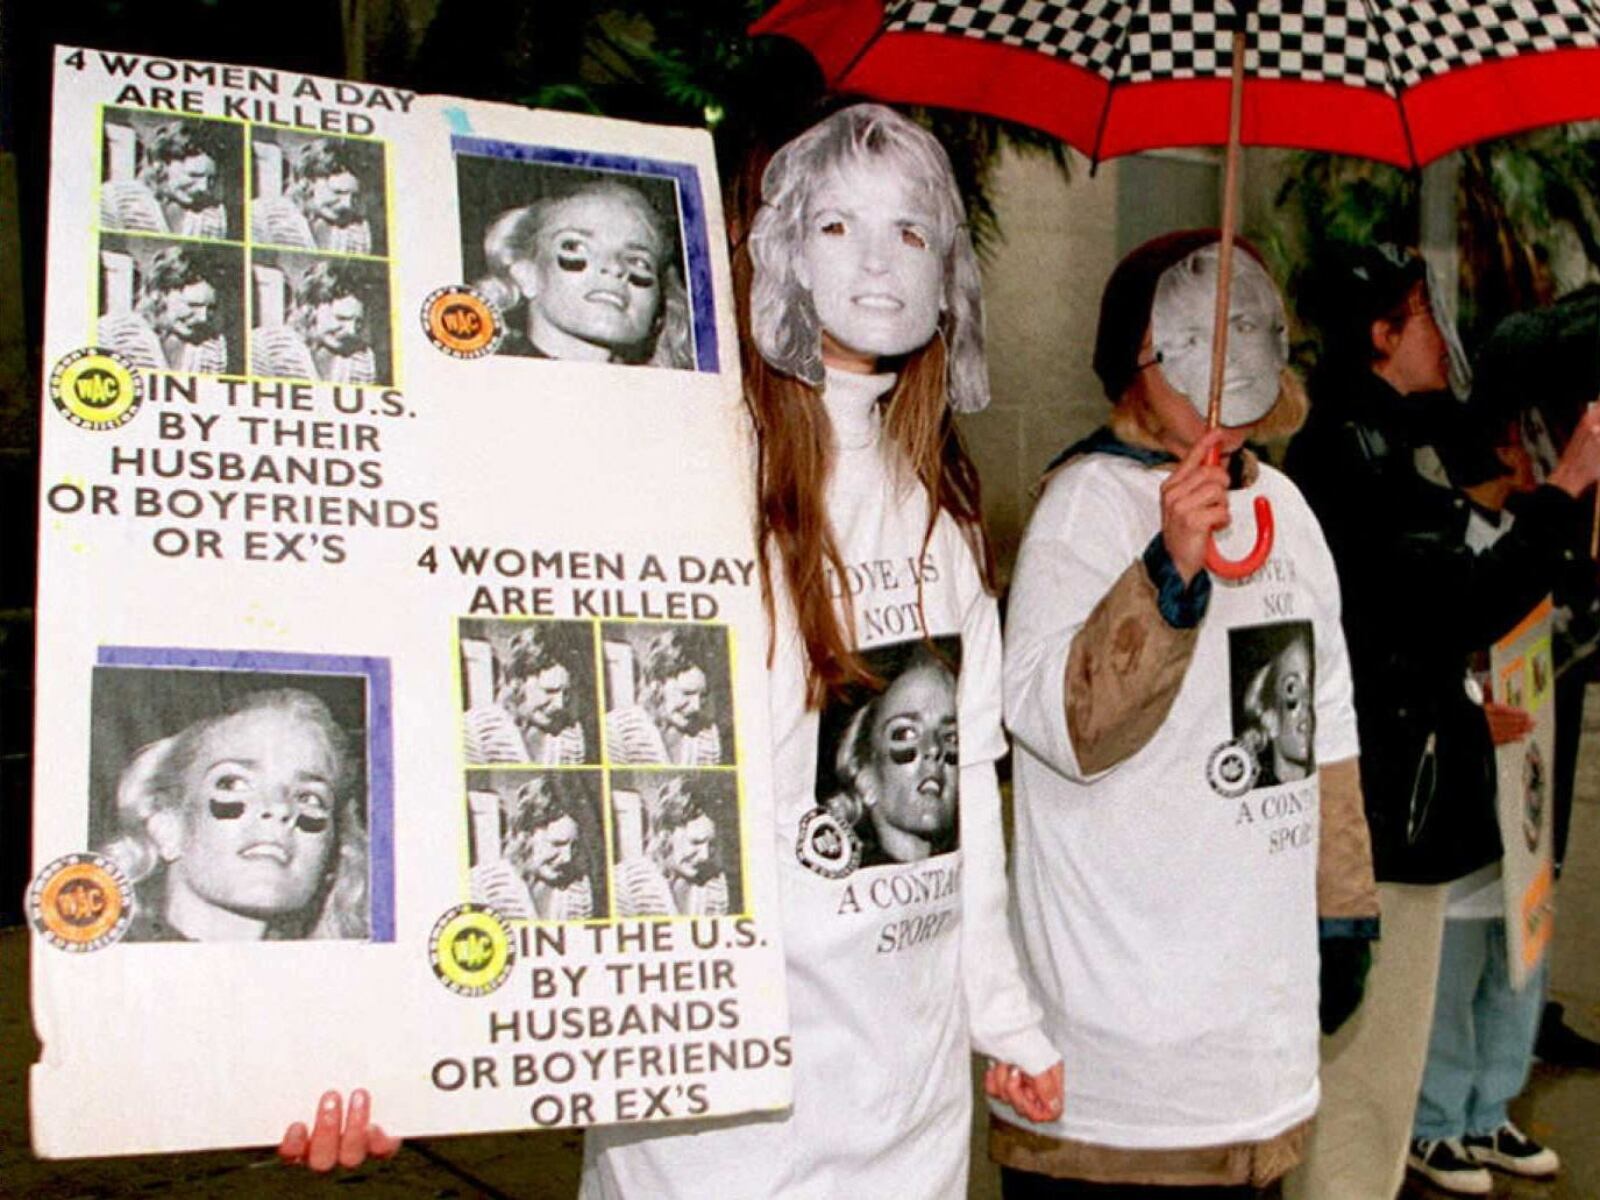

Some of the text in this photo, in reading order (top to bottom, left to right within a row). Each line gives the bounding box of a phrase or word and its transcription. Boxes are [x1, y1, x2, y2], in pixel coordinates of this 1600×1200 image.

[65, 49, 415, 113] 4 WOMEN A DAY
[116, 83, 376, 136] ARE KILLED
[77, 373, 118, 404] WAC
[149, 374, 417, 418] IN THE U.S.
[158, 411, 381, 453] BY THEIR
[111, 445, 384, 489] HUSBANDS
[47, 482, 440, 531] OR BOYFRIENDS
[153, 527, 348, 565] OR EX'S
[417, 545, 756, 587] 4 WOMEN A DAY
[468, 585, 720, 621] ARE KILLED
[863, 602, 921, 641] NOT
[1236, 801, 1254, 825] A
[838, 885, 862, 915] A
[520, 919, 768, 958] IN THE U.S.
[876, 909, 955, 954] SPORT
[532, 965, 588, 999] BY
[605, 959, 738, 996] THEIR
[489, 997, 740, 1045] HUSBANDS
[431, 1034, 794, 1093] OR BOYFRIENDS
[530, 1083, 710, 1127] OR EX'S
